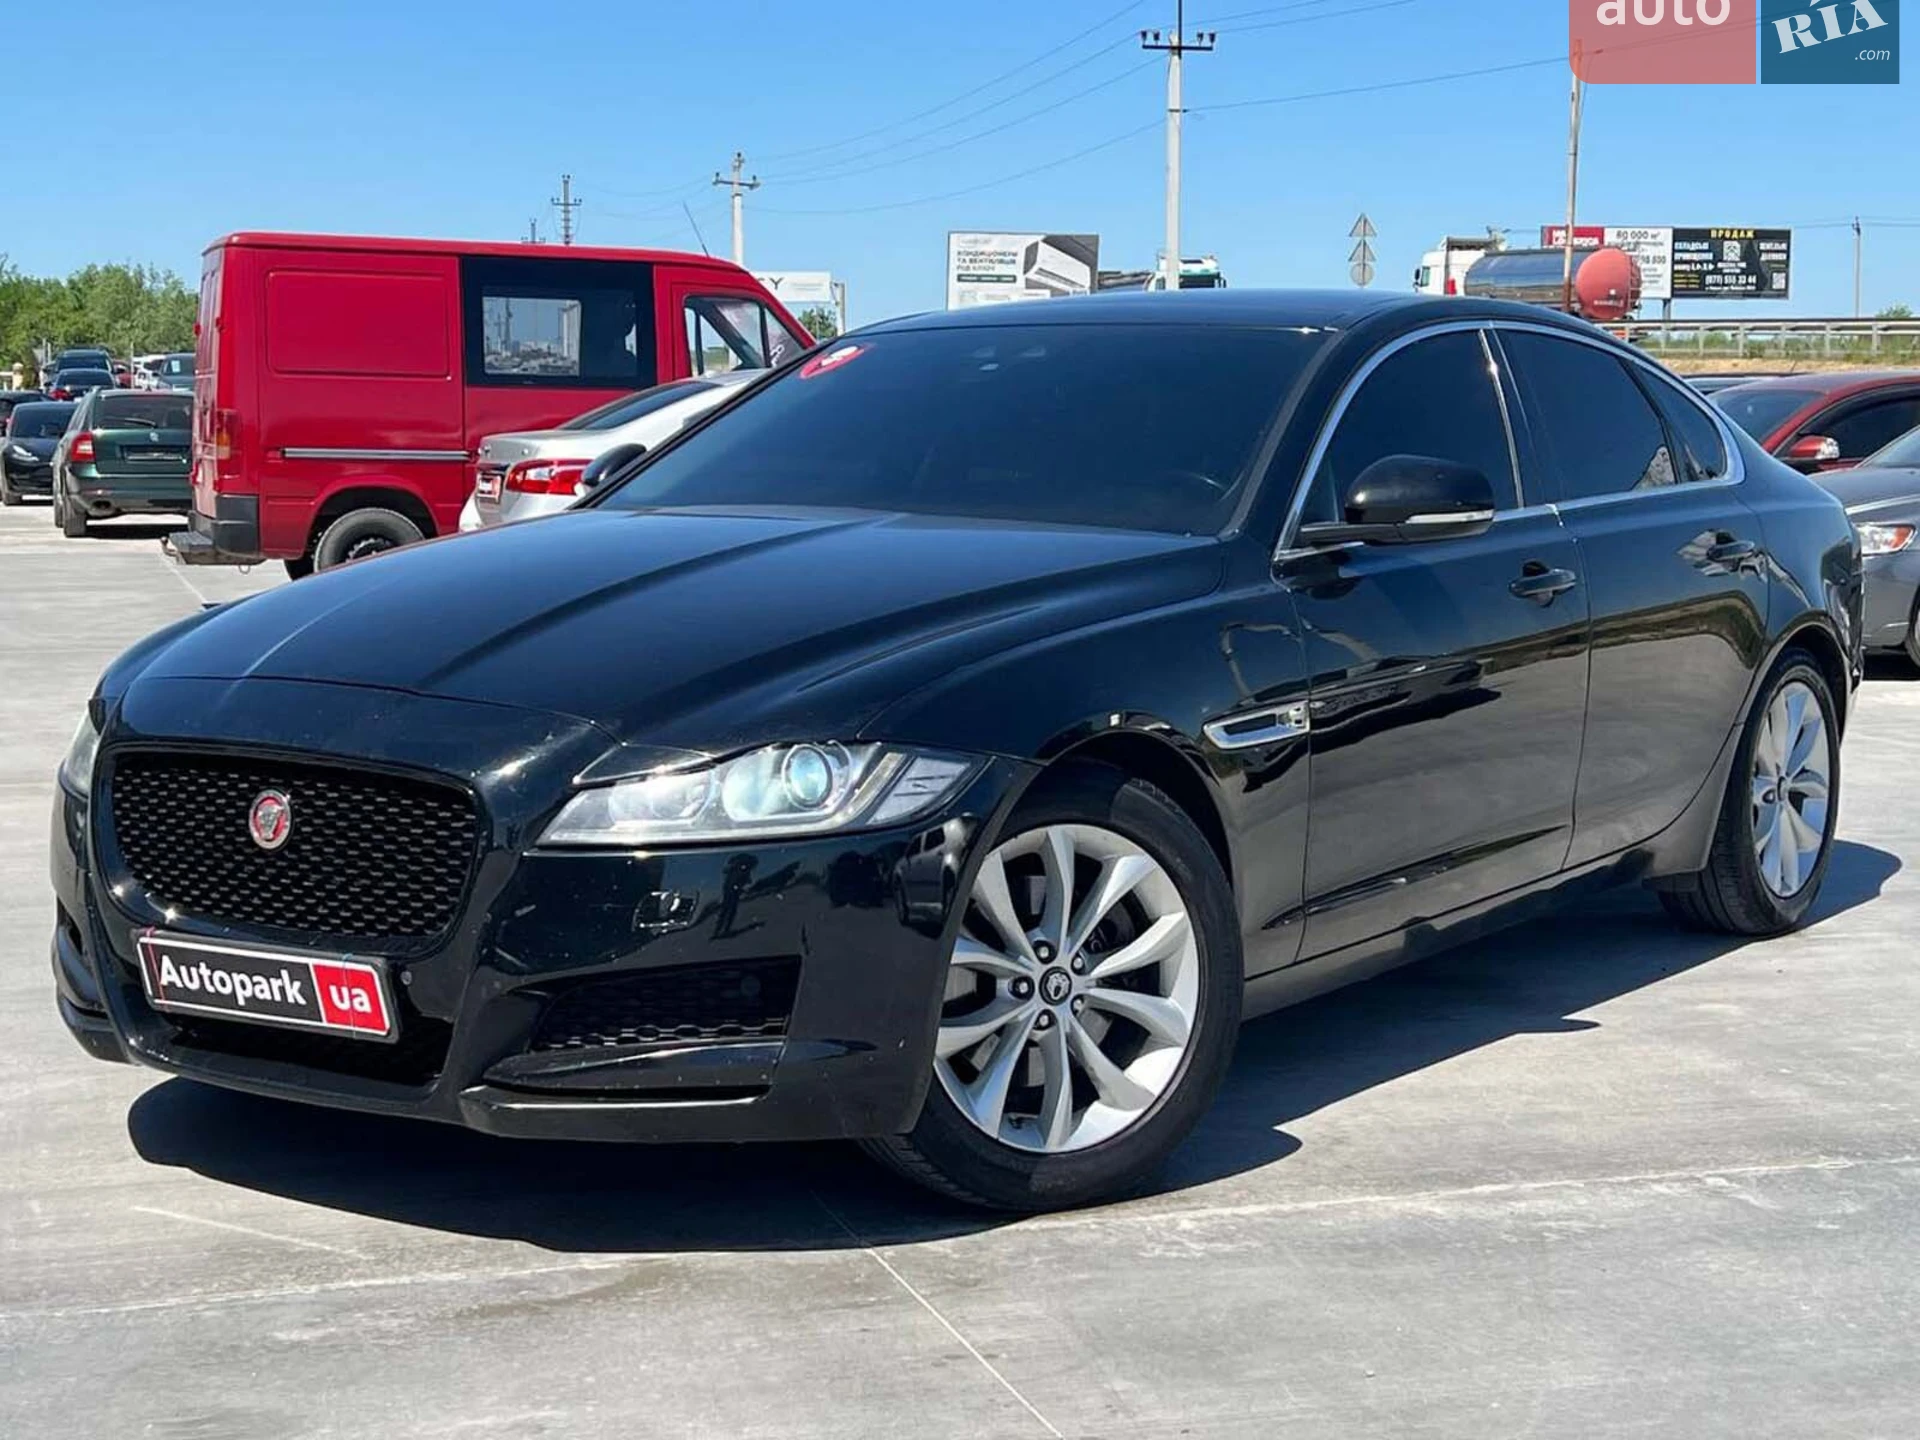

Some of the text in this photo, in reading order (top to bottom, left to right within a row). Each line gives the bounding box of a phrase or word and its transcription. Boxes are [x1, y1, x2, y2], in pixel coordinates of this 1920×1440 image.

[1710, 229, 1754, 239] ПРОДАЖ
[160, 954, 372, 1013] Autopark ua
